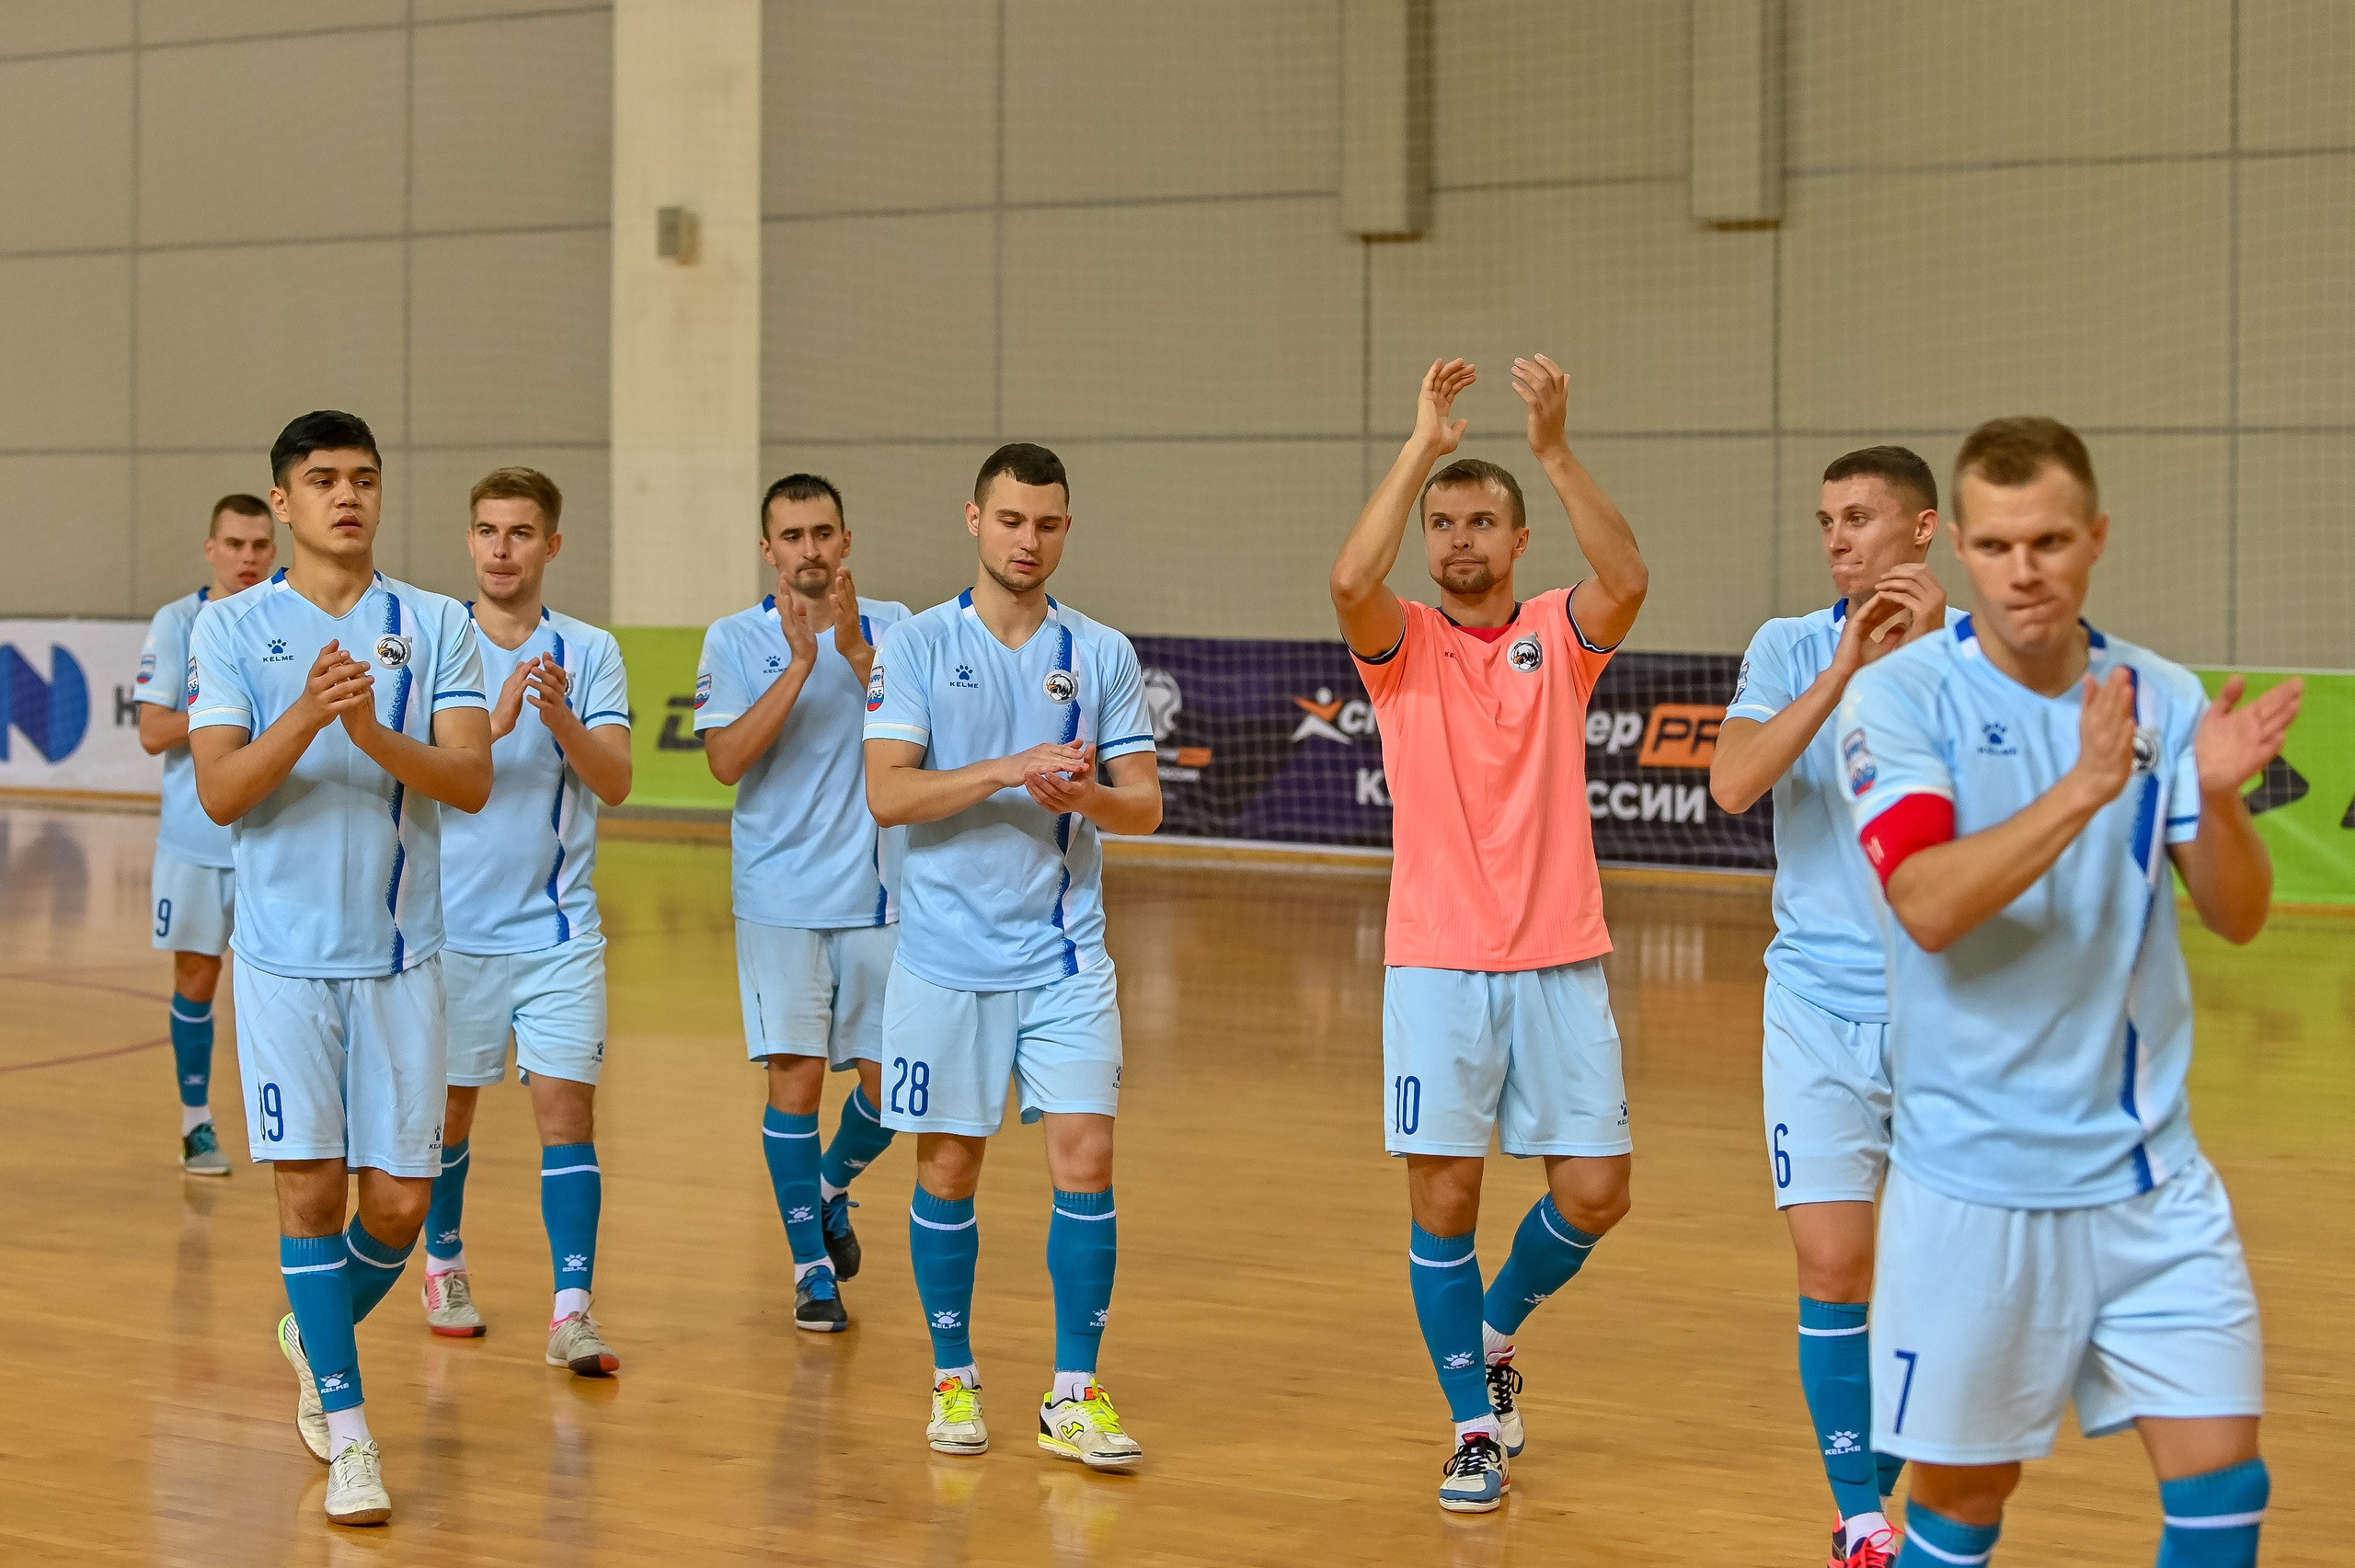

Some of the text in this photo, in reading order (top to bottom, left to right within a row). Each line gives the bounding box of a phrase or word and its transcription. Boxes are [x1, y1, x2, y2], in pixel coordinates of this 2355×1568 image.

[262, 655, 294, 663] KELME
[1585, 711, 1643, 754] ер
[1586, 780, 1707, 824] ССИИ
[155, 898, 172, 938] 9
[890, 1056, 930, 1117] 28
[1395, 1075, 1421, 1136] 10
[1774, 1123, 1791, 1189] 6
[931, 1322, 962, 1330] KELME
[320, 1382, 350, 1394] KELME
[1895, 1350, 1918, 1435] 7
[1824, 1445, 1862, 1456] KELME
